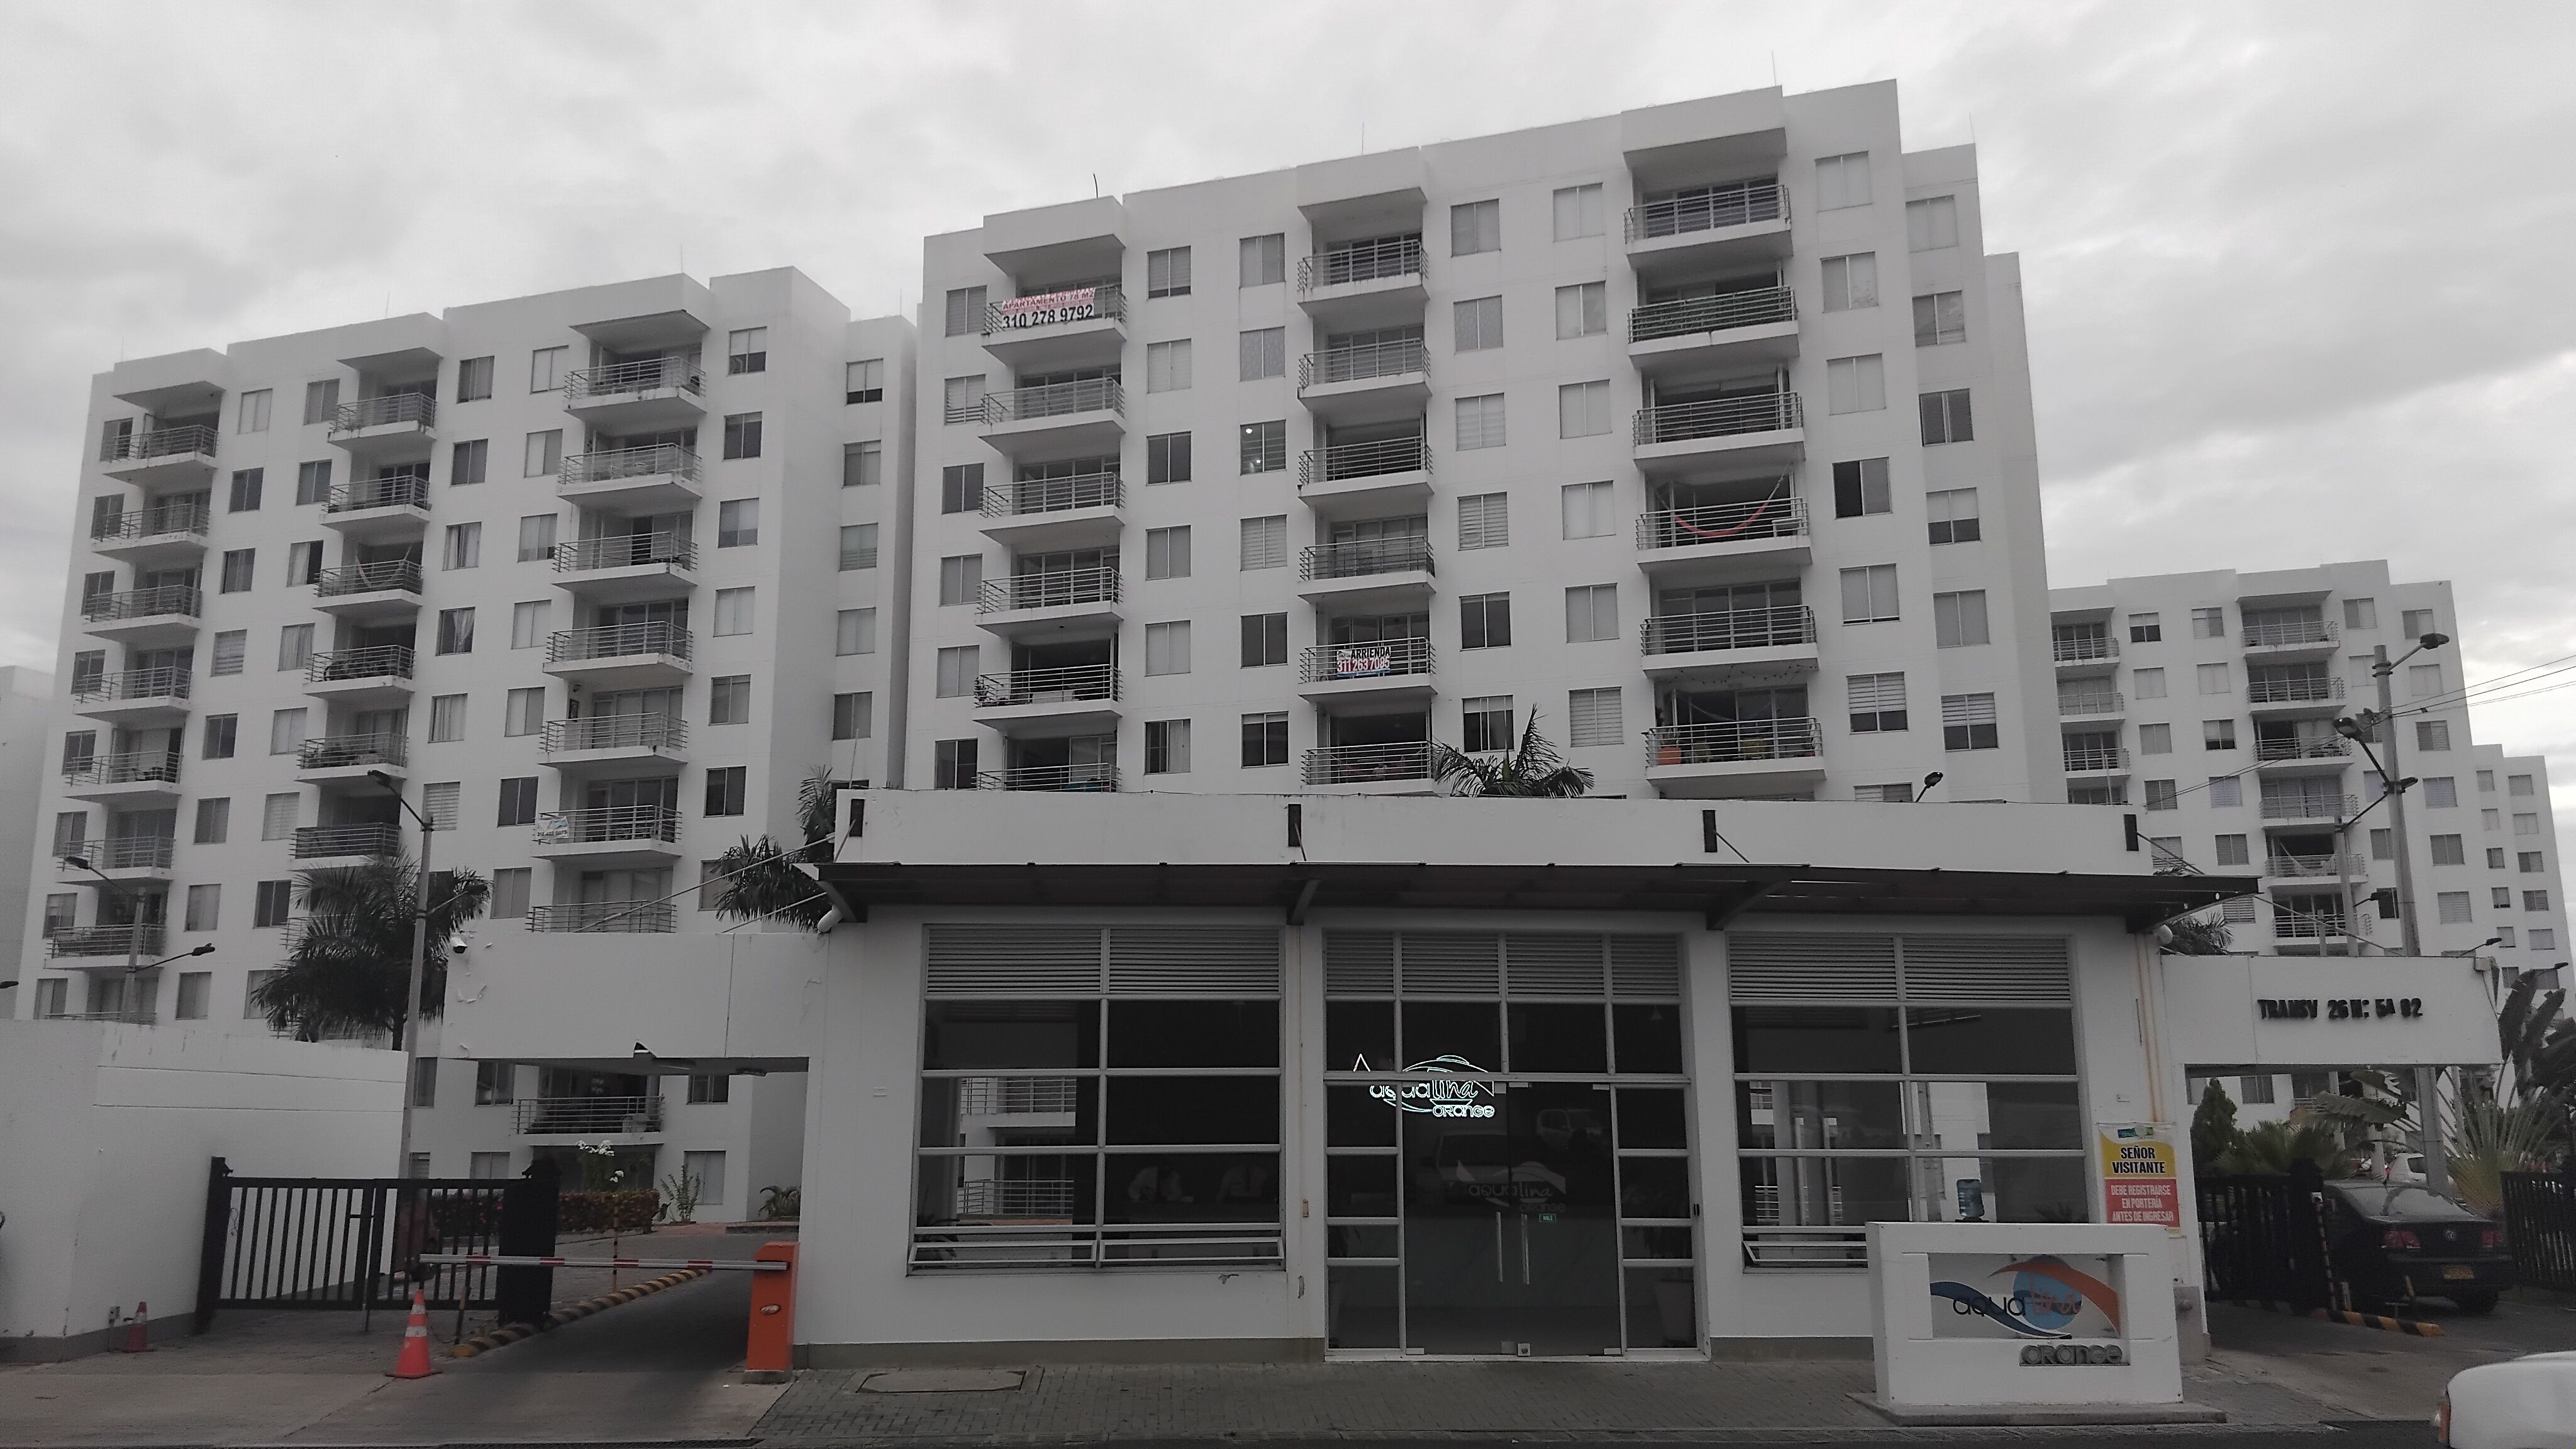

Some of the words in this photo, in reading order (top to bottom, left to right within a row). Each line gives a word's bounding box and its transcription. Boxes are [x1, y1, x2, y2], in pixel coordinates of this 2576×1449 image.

[1003, 296, 1066, 310] APARTAMENTO
[1002, 313, 1026, 328] 310
[1031, 309, 1055, 325] 278
[1060, 304, 1093, 321] 9792
[1351, 647, 1390, 659] ARRIENDA
[2121, 1145, 2155, 1158] SEÑOR
[2112, 1162, 2166, 1174] VISITANTE
[2111, 1185, 2127, 1195] DEBE
[2128, 1185, 2171, 1195] REGISTRARSE
[2122, 1198, 2131, 1208] EN
[2131, 1196, 2162, 1208] PORTERÍA
[2112, 1211, 2133, 1221] ANTES
[2134, 1211, 2142, 1221] DE
[2143, 1211, 2174, 1221] INGRESAR
